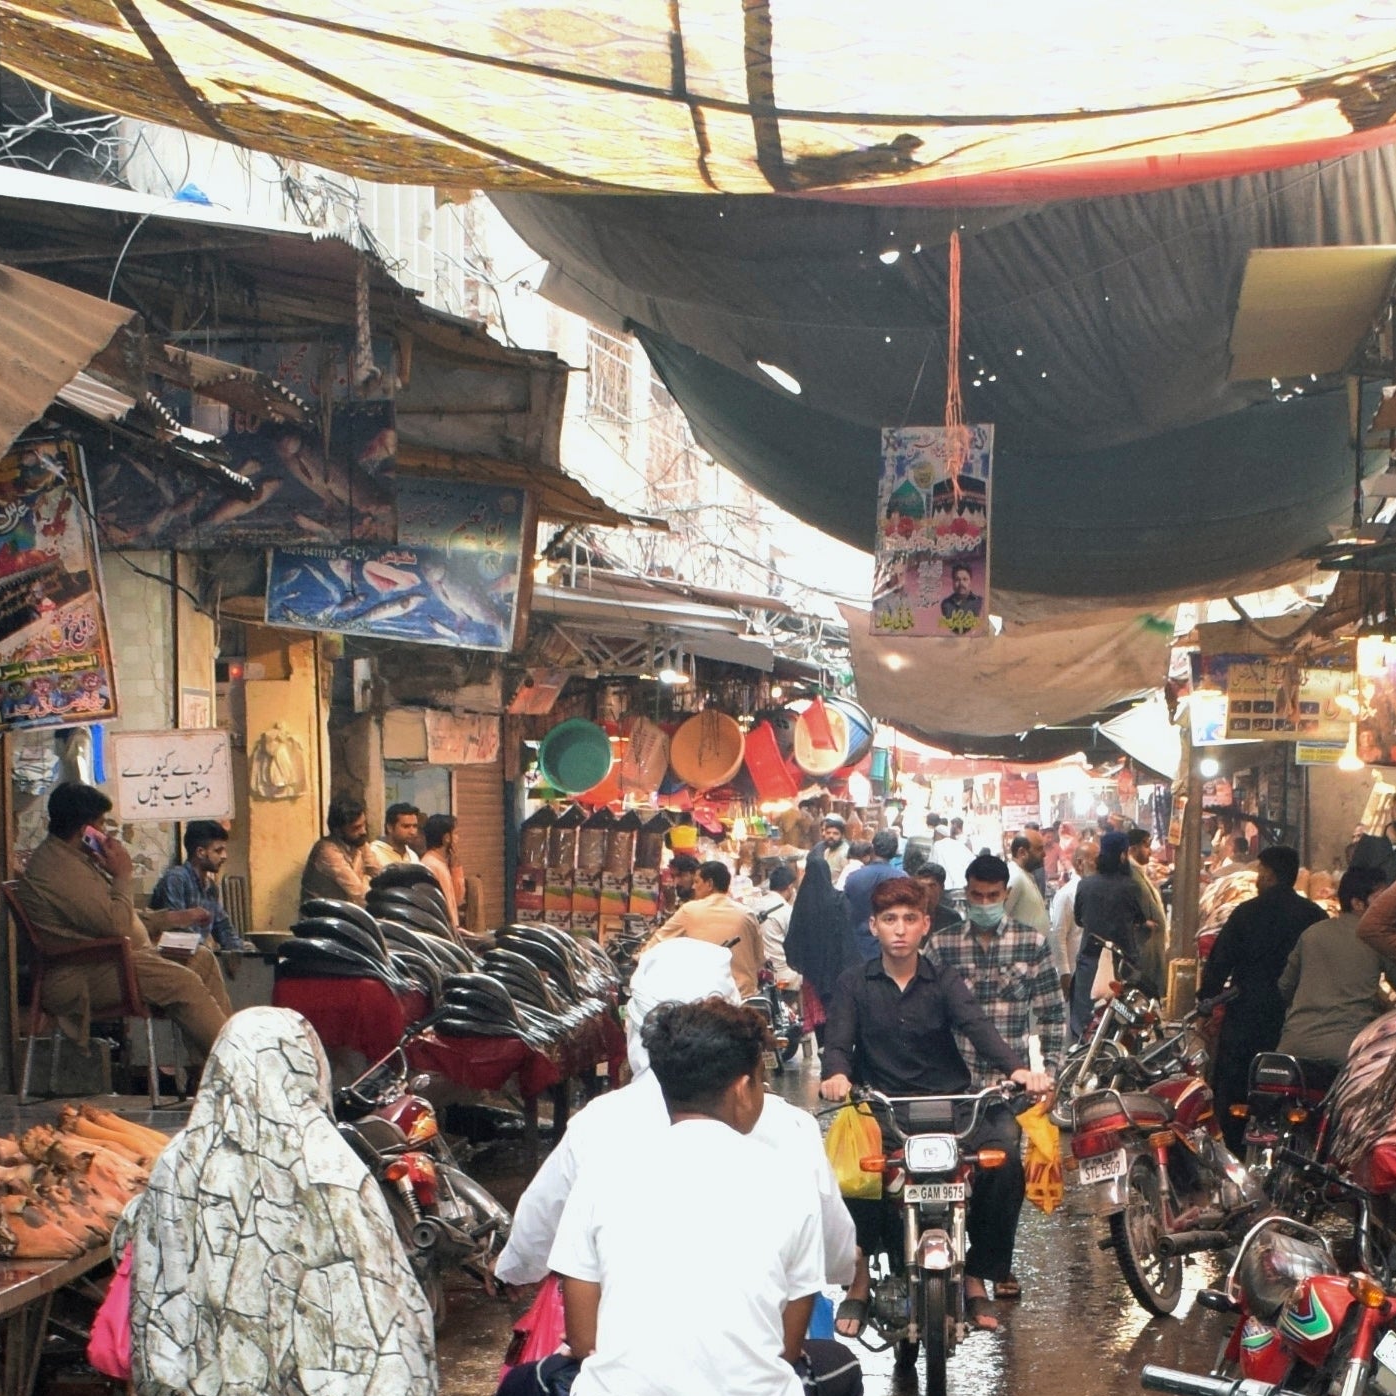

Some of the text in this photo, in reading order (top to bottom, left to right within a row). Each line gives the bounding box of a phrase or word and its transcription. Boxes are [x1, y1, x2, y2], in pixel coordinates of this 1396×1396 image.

[172, 742, 225, 775] گردے
[137, 780, 211, 807] دستیاب ہیں
[1085, 1161, 1120, 1180] STL 5509
[920, 1184, 964, 1199] GAM 9675
